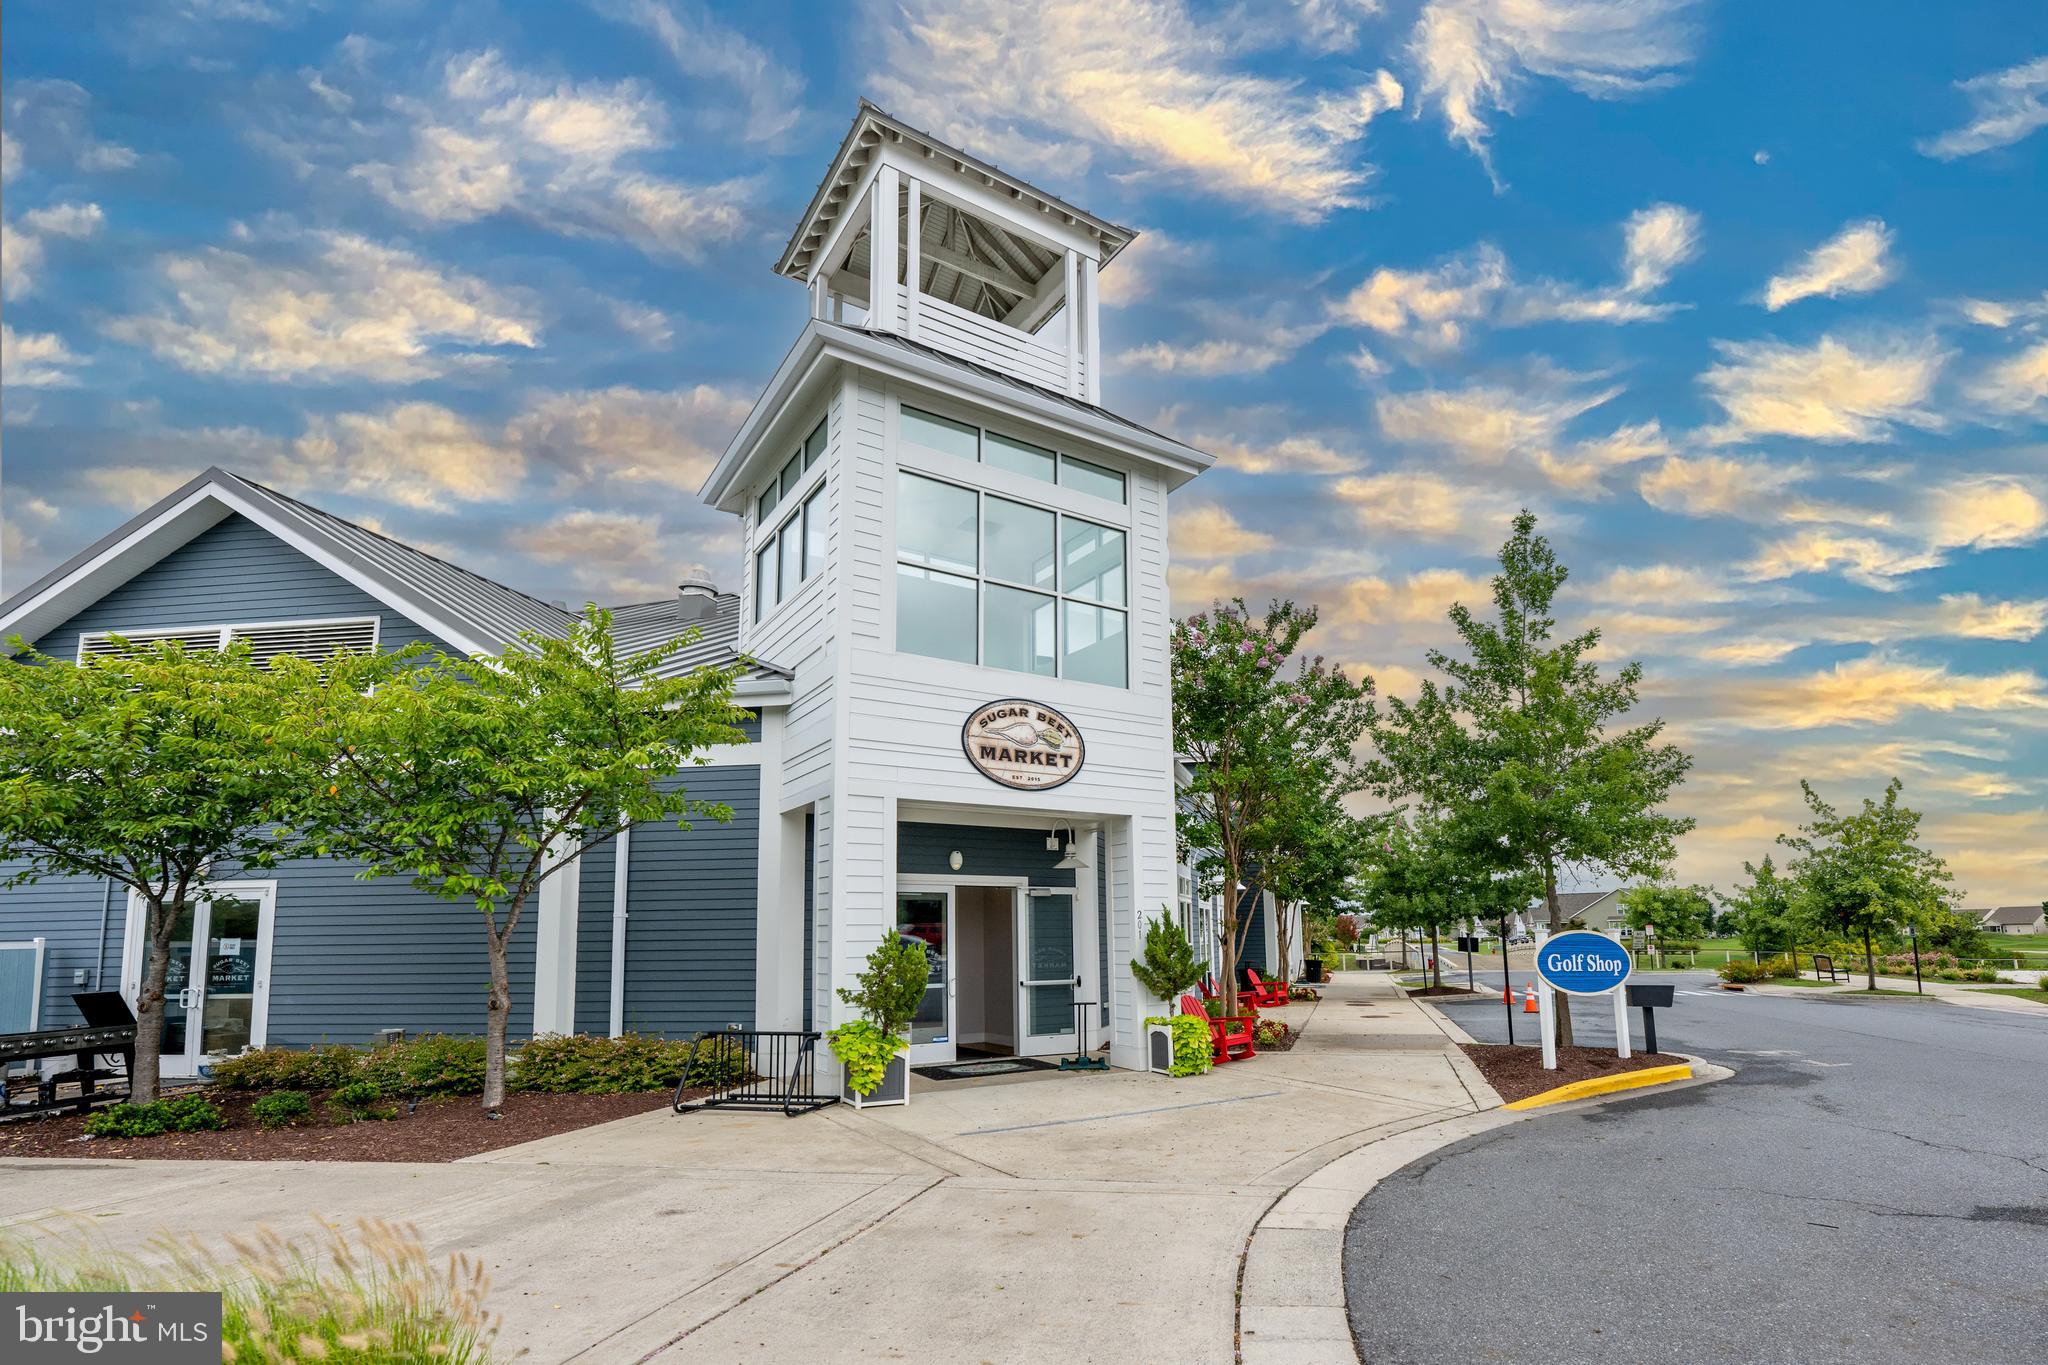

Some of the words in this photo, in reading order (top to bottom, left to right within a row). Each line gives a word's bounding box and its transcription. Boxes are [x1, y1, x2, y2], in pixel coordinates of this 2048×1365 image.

[979, 707, 1029, 729] SUGAR
[1037, 711, 1072, 738] BEET
[980, 746, 1073, 768] MARKET
[212, 958, 233, 969] SUGAR
[235, 959, 250, 969] BEET
[1547, 953, 1584, 972] Golf
[1587, 954, 1622, 976] Shop
[212, 974, 250, 982] MARKET
